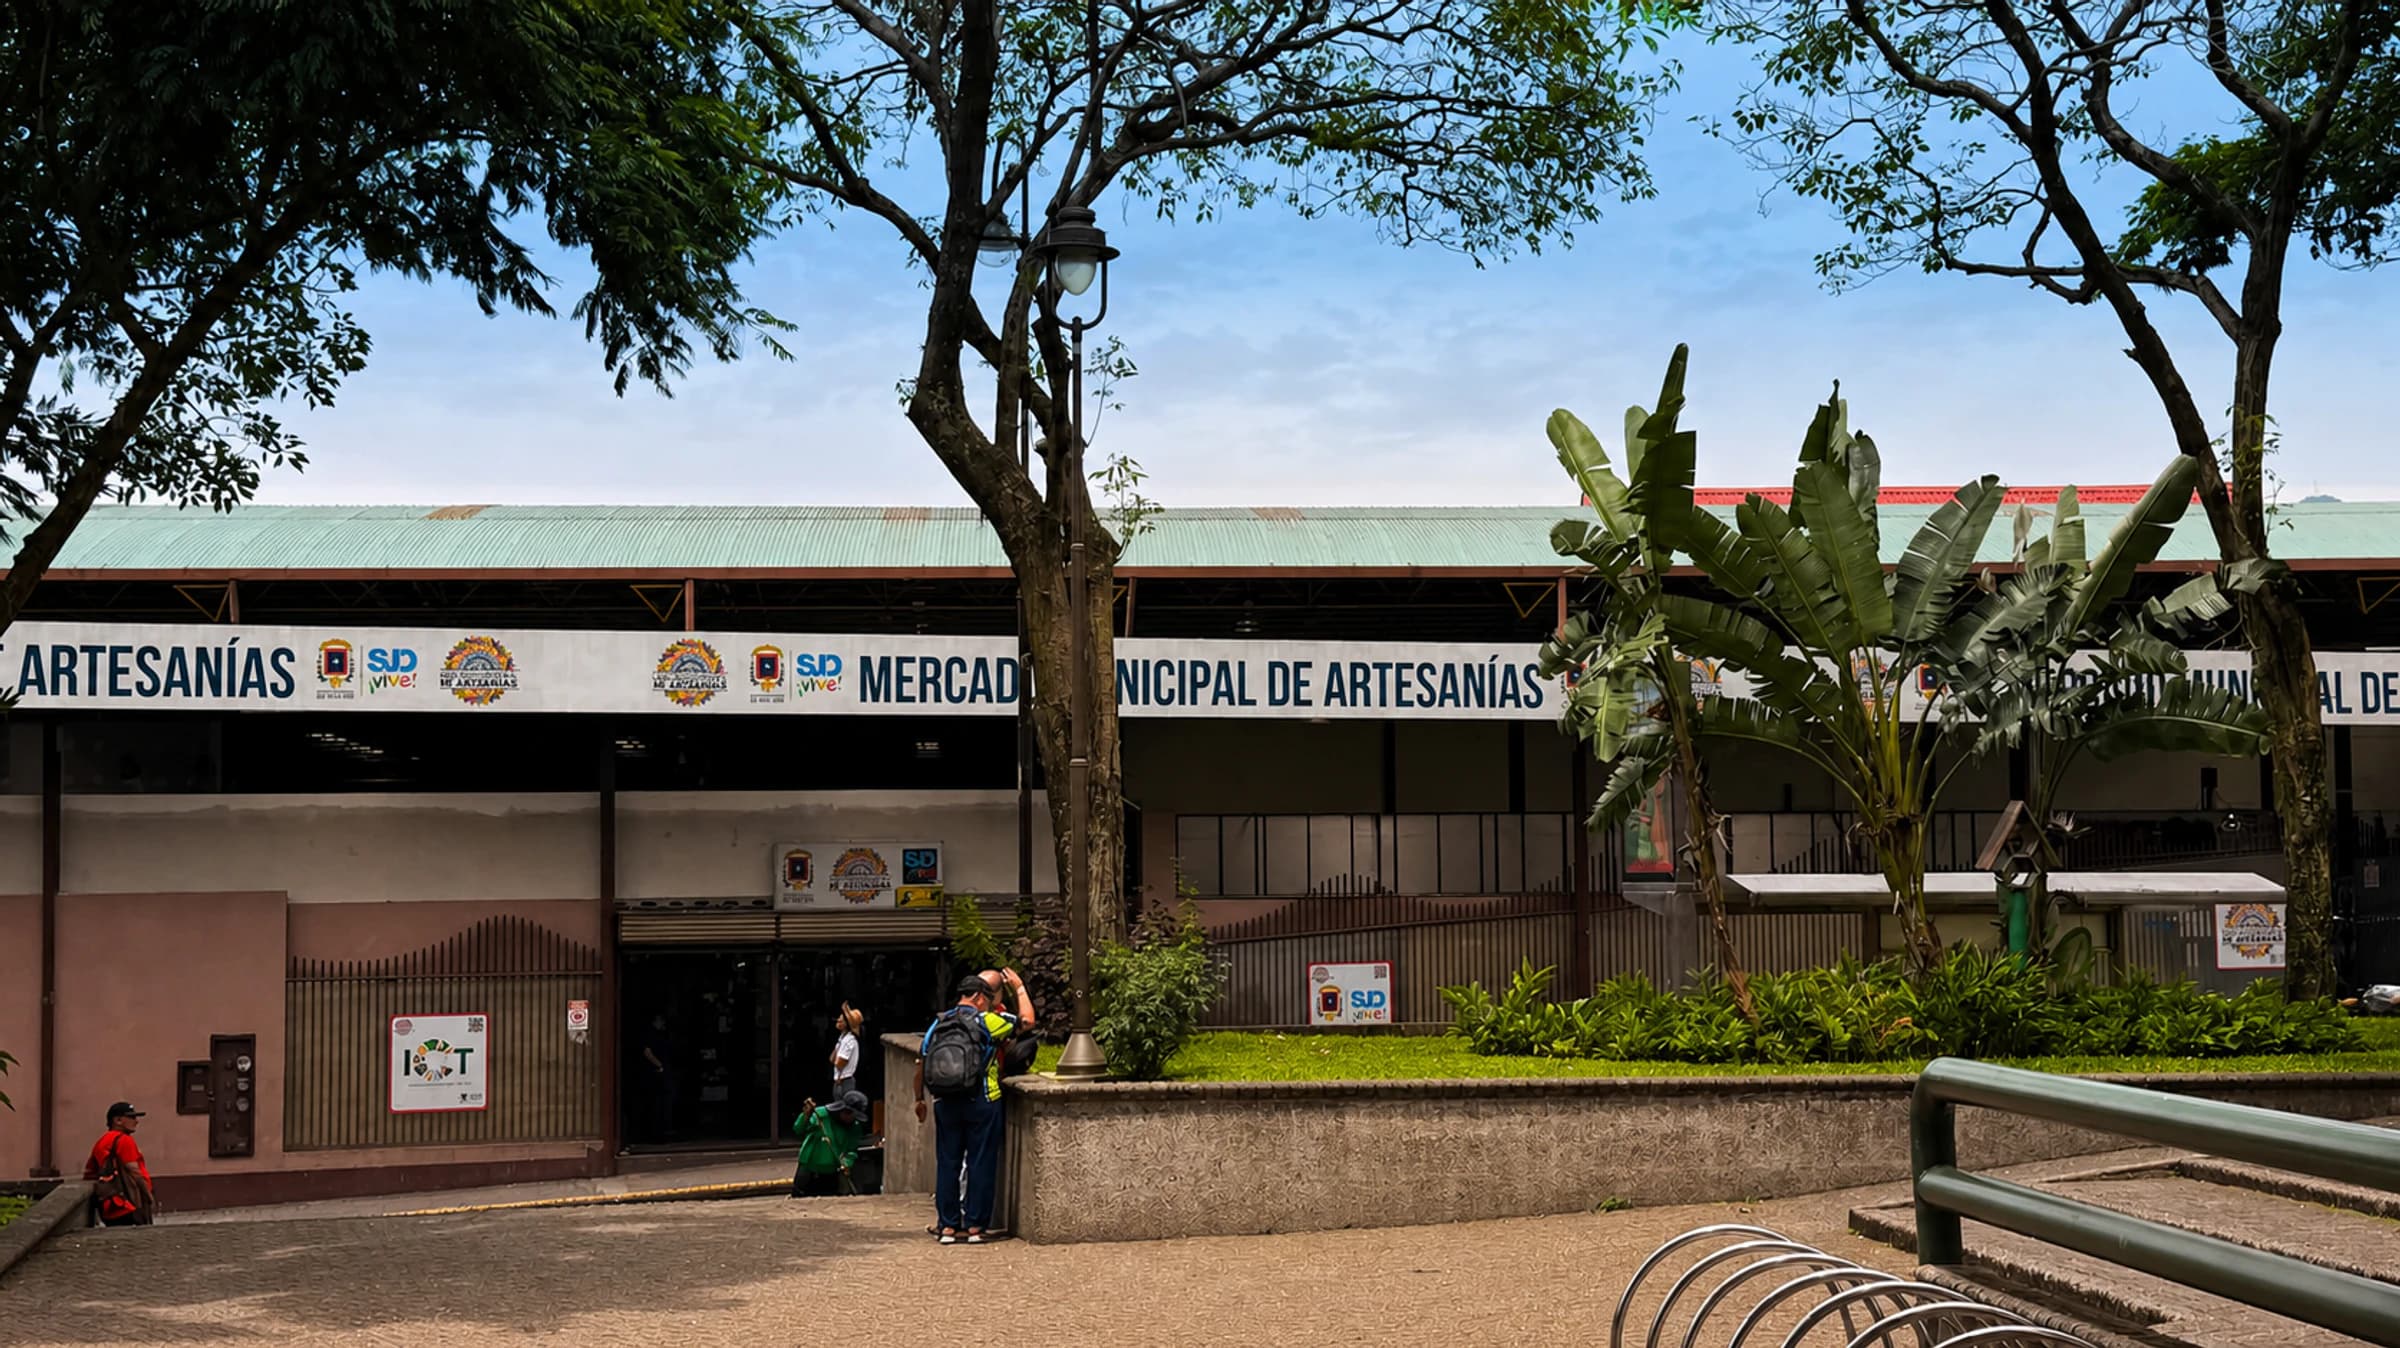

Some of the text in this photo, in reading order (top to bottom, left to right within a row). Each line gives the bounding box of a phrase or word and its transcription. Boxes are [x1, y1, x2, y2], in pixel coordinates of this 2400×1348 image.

[18, 637, 296, 699] ARTESANÍAS
[859, 654, 1543, 709] MERCAD NICIPAL DE ARTESANÍAS
[2361, 671, 2400, 714] DE
